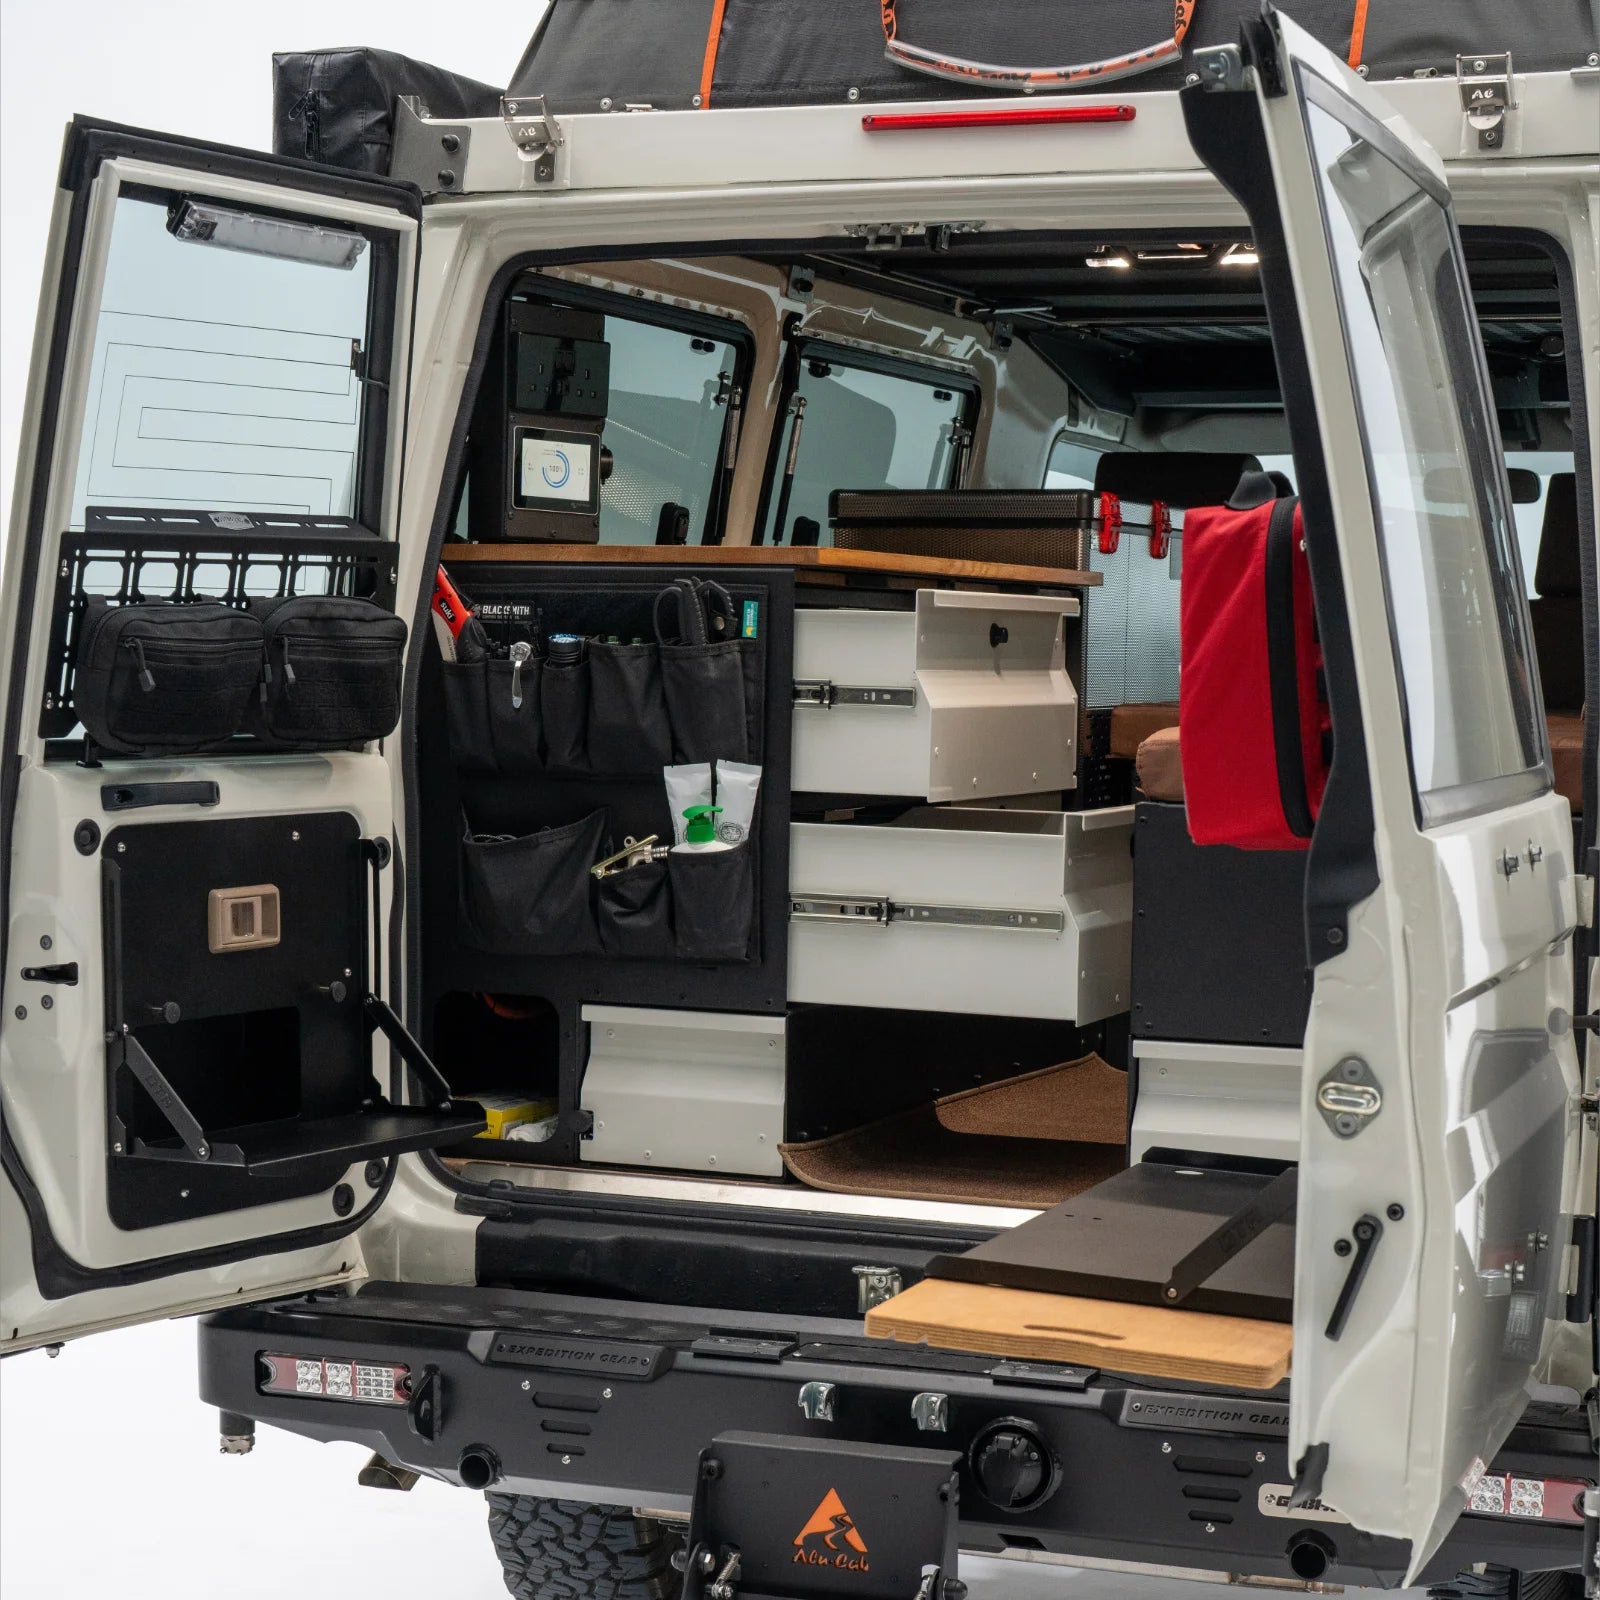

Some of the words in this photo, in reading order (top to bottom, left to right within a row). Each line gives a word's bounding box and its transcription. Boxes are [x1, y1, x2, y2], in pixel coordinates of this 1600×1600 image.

[440, 601, 455, 620] suki
[508, 1344, 595, 1362] EXPEDITION
[600, 1353, 638, 1366] GEAR
[1144, 1403, 1244, 1422] EXPEDITION
[792, 1548, 871, 1573] Alu-Cab
